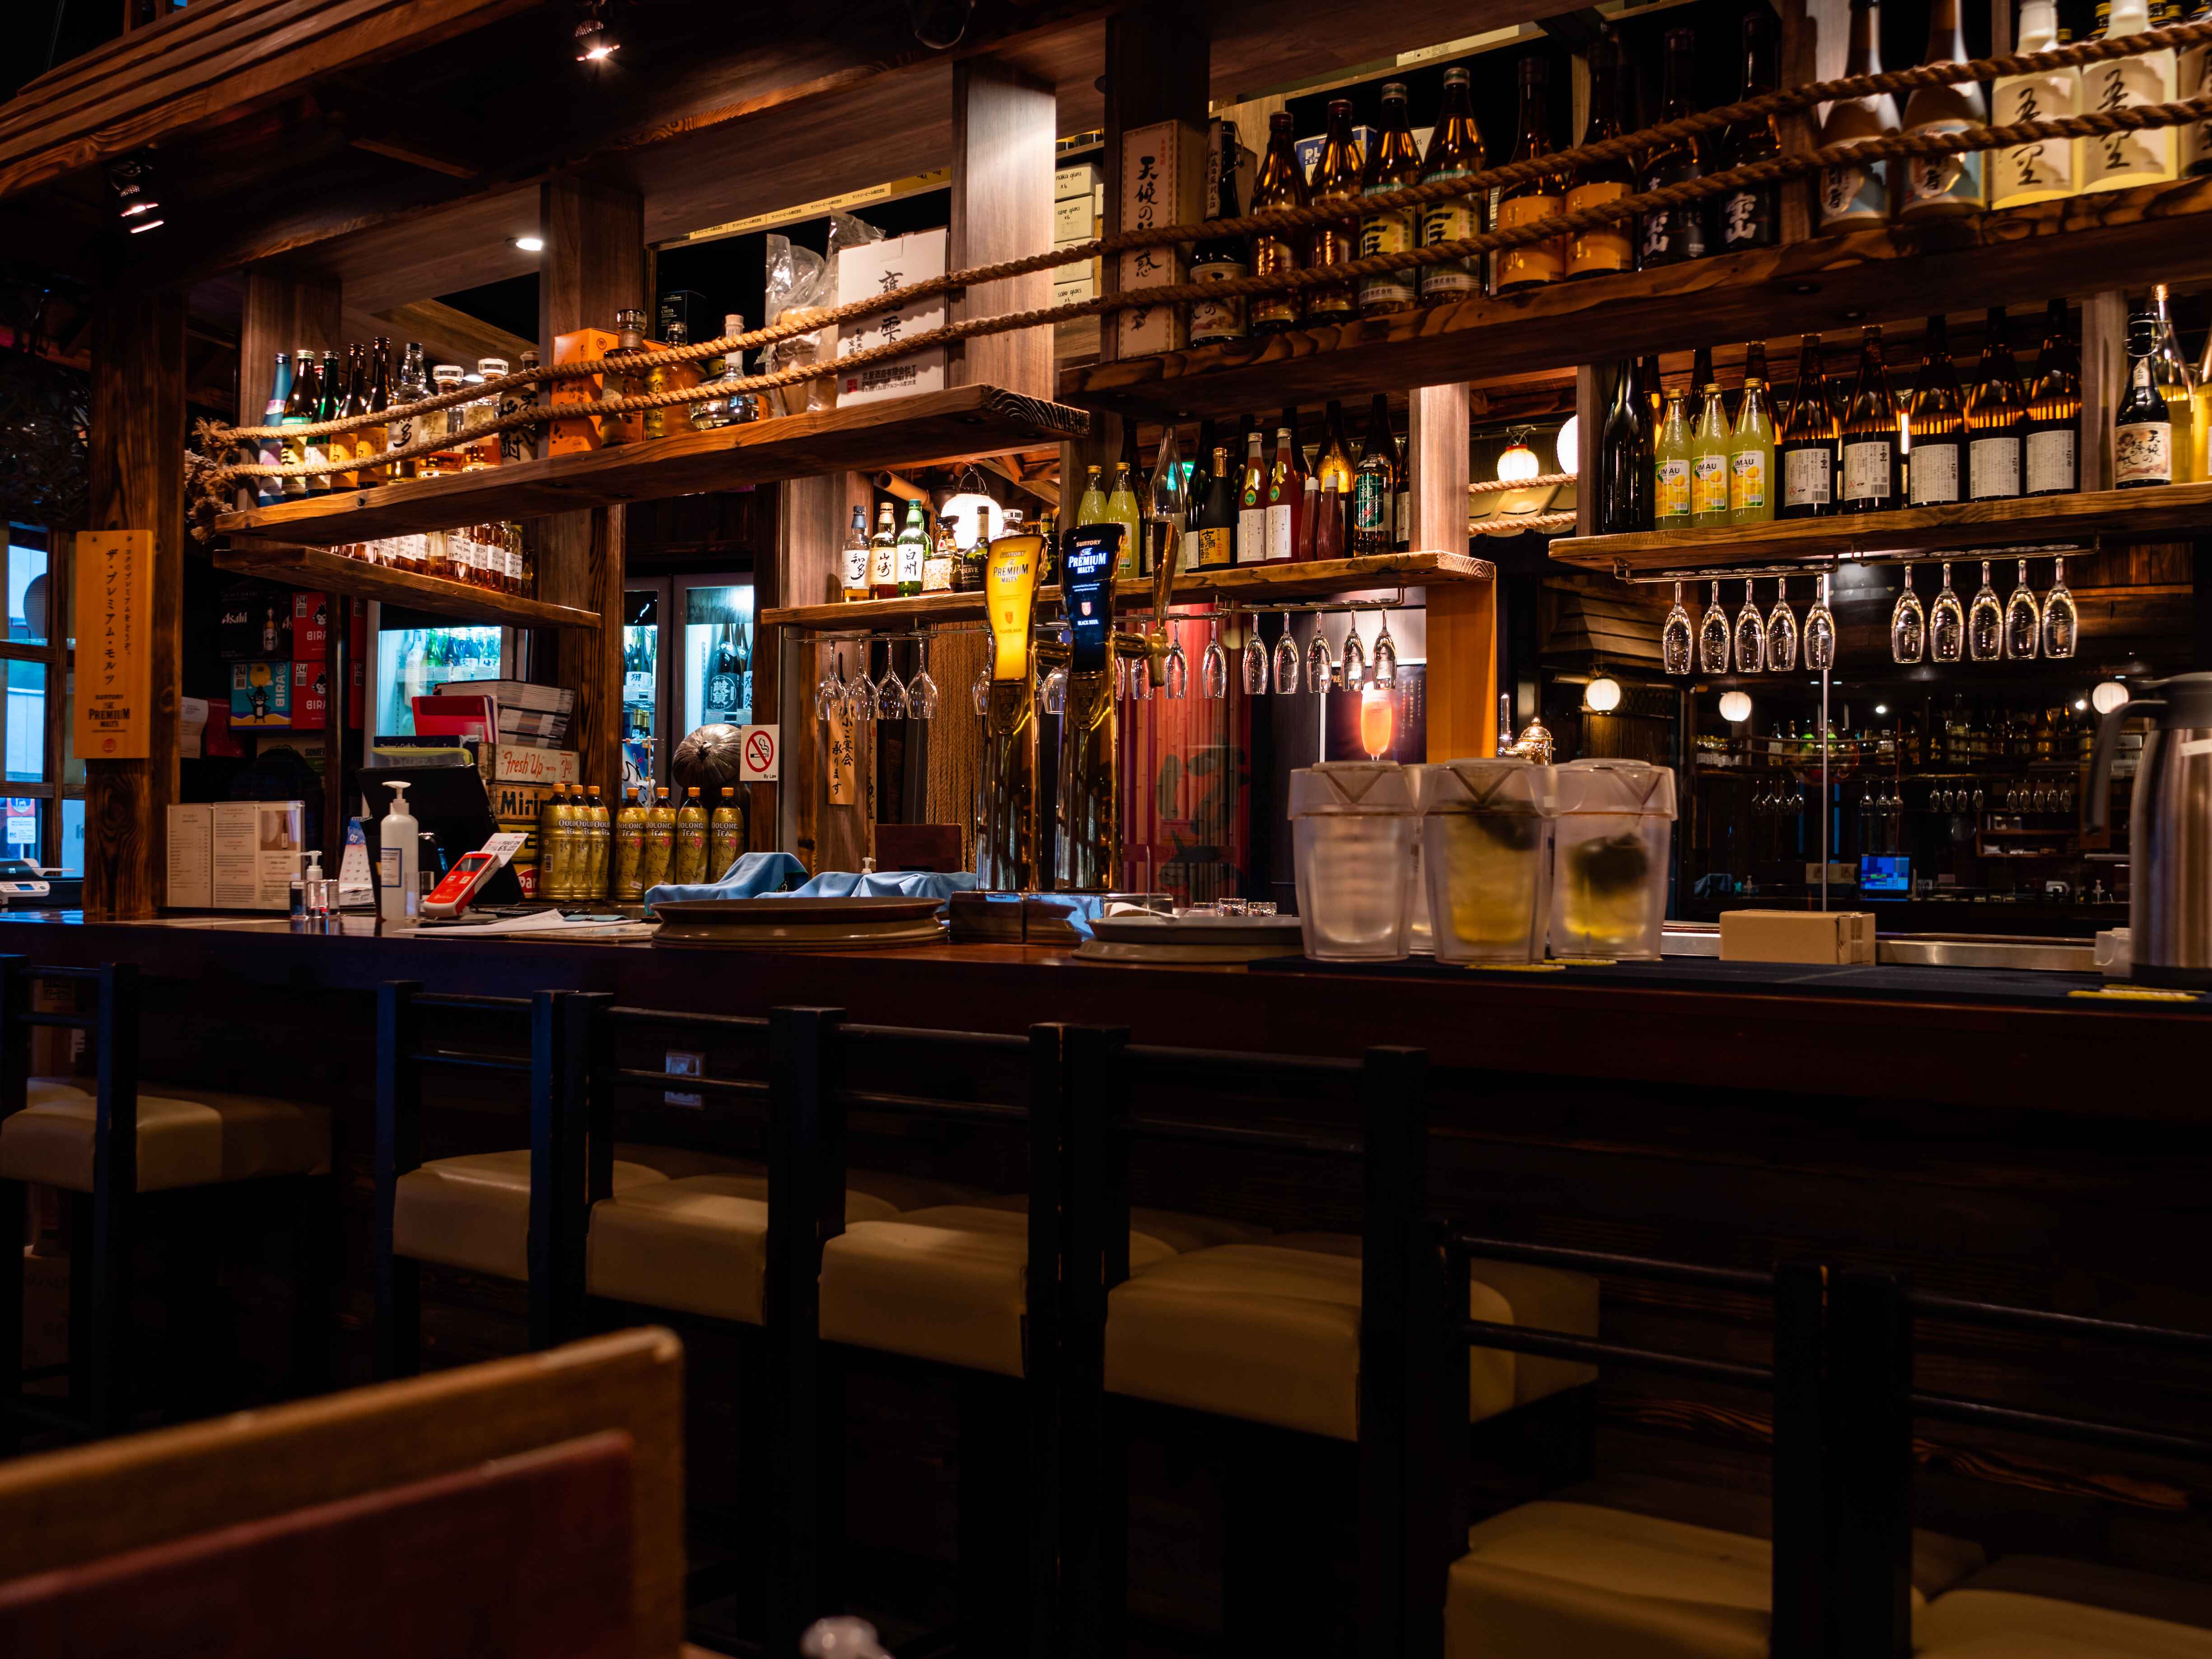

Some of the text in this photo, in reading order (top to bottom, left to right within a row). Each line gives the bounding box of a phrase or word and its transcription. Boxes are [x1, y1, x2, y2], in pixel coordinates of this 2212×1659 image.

[1069, 171, 1082, 180] glass
[1069, 206, 1080, 214] glass
[1134, 155, 1163, 277] 天使の惑
[1070, 288, 1082, 296] glass
[1694, 463, 1717, 471] LIMAU
[1732, 458, 1754, 466] LIMAU
[850, 553, 865, 580] 知多
[877, 552, 891, 577] 山崎
[904, 548, 917, 576] 白州
[1068, 553, 1106, 568] PREMIUM
[994, 564, 1029, 577] PREMIUM
[104, 548, 118, 685] ザ・プレミアム・モルツ
[221, 611, 248, 625] Asahi
[89, 708, 130, 720] PREMIUM
[504, 751, 528, 775] Fresh
[531, 753, 543, 778] Up
[831, 741, 843, 795] 承ります
[617, 821, 644, 830] OOLONG
[646, 821, 672, 830] OOLONG
[678, 821, 704, 830] OOLONG
[712, 821, 738, 830] OOLONG
[349, 834, 358, 843] 07
